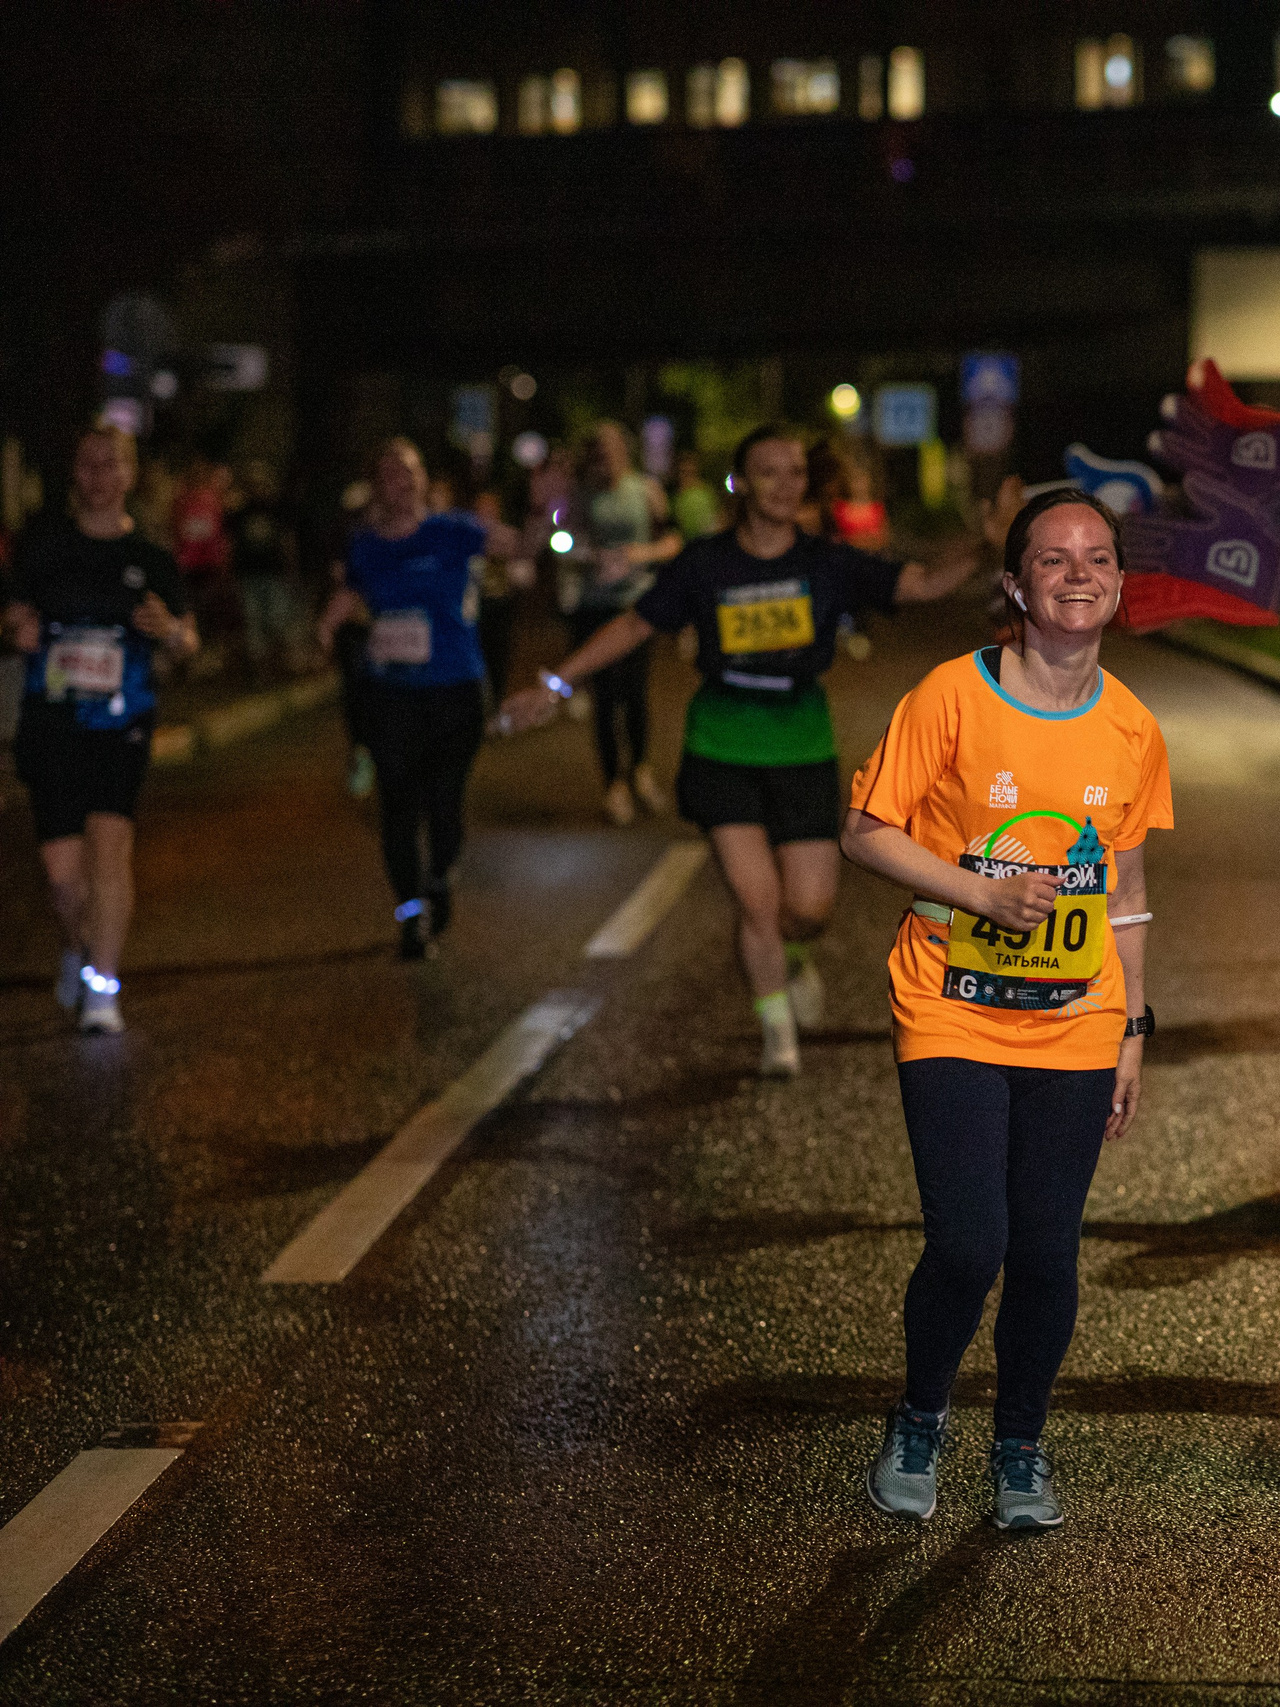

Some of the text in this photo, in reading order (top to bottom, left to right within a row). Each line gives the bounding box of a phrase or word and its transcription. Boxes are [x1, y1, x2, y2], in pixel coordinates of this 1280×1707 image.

[990, 784, 1018, 795] БЕЛЫЕ
[989, 793, 1018, 804] НОЧИ
[995, 952, 1060, 969] ТАТЬЯНА
[959, 974, 978, 999] G
